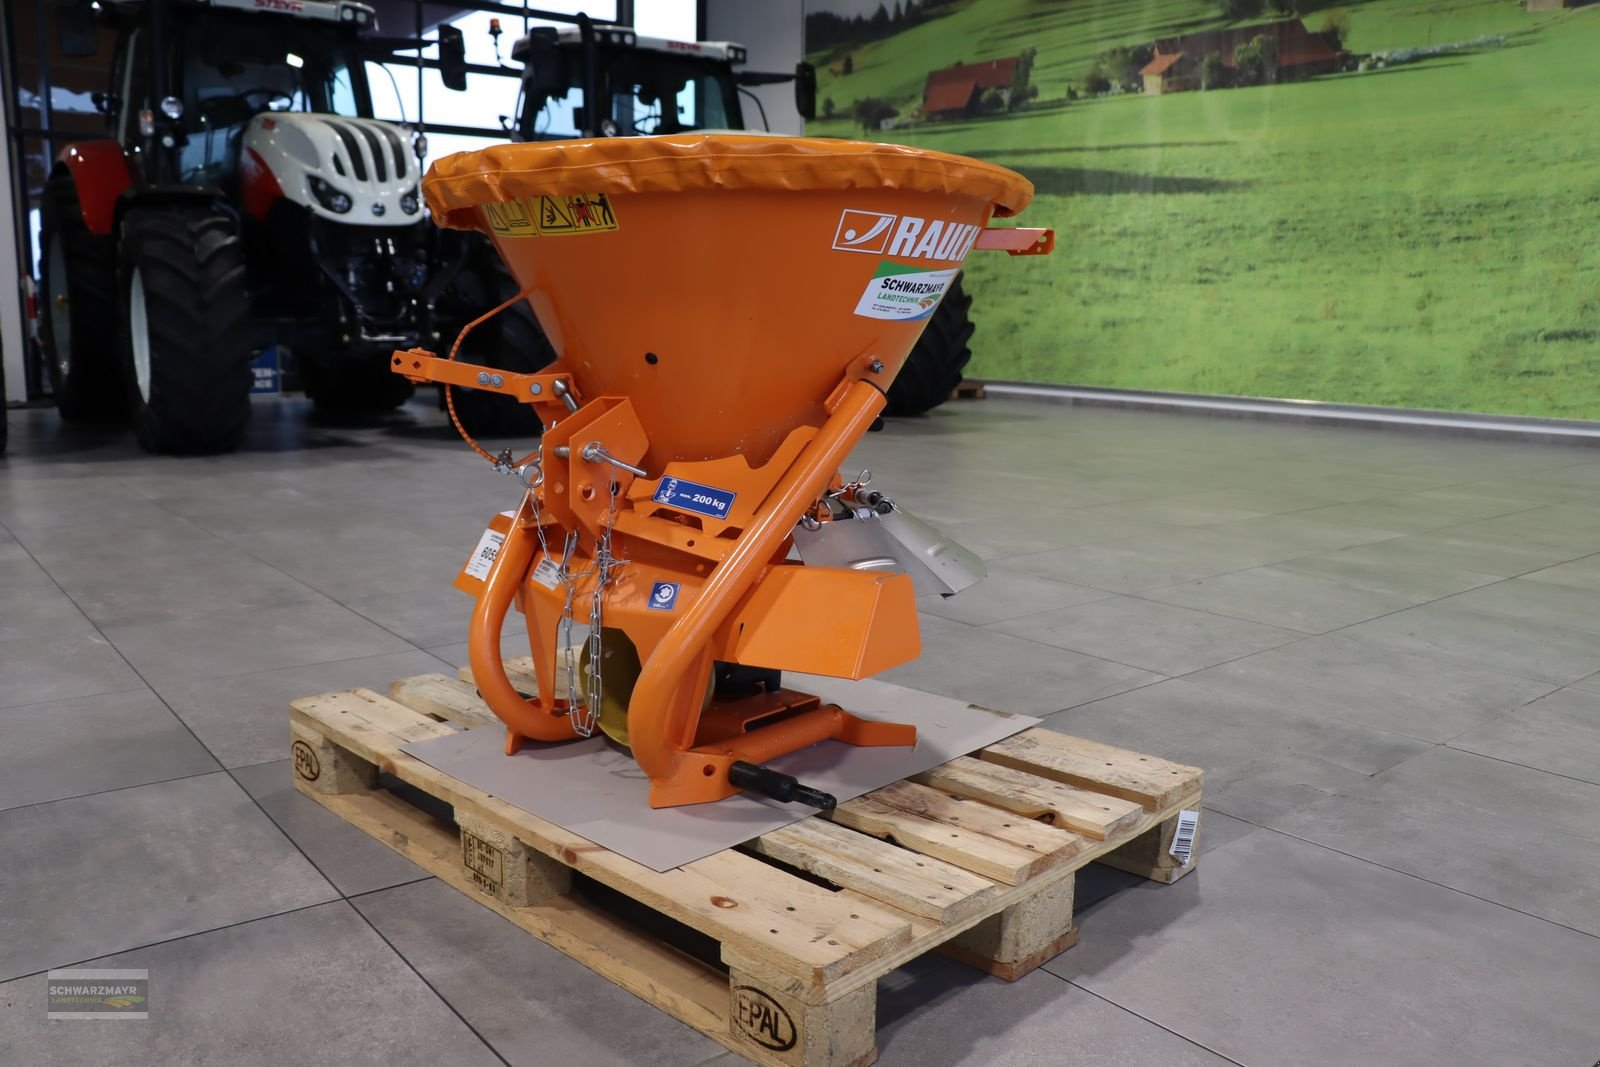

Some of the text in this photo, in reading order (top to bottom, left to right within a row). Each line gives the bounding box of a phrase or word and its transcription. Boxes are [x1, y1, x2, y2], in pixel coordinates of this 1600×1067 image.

[888, 216, 981, 262] RAUCH
[880, 277, 945, 295] SCHWARZMAYR
[876, 292, 920, 304] LANDTECHNIK
[692, 493, 712, 505] 200
[712, 498, 726, 511] kg
[738, 994, 787, 1046] EPAL
